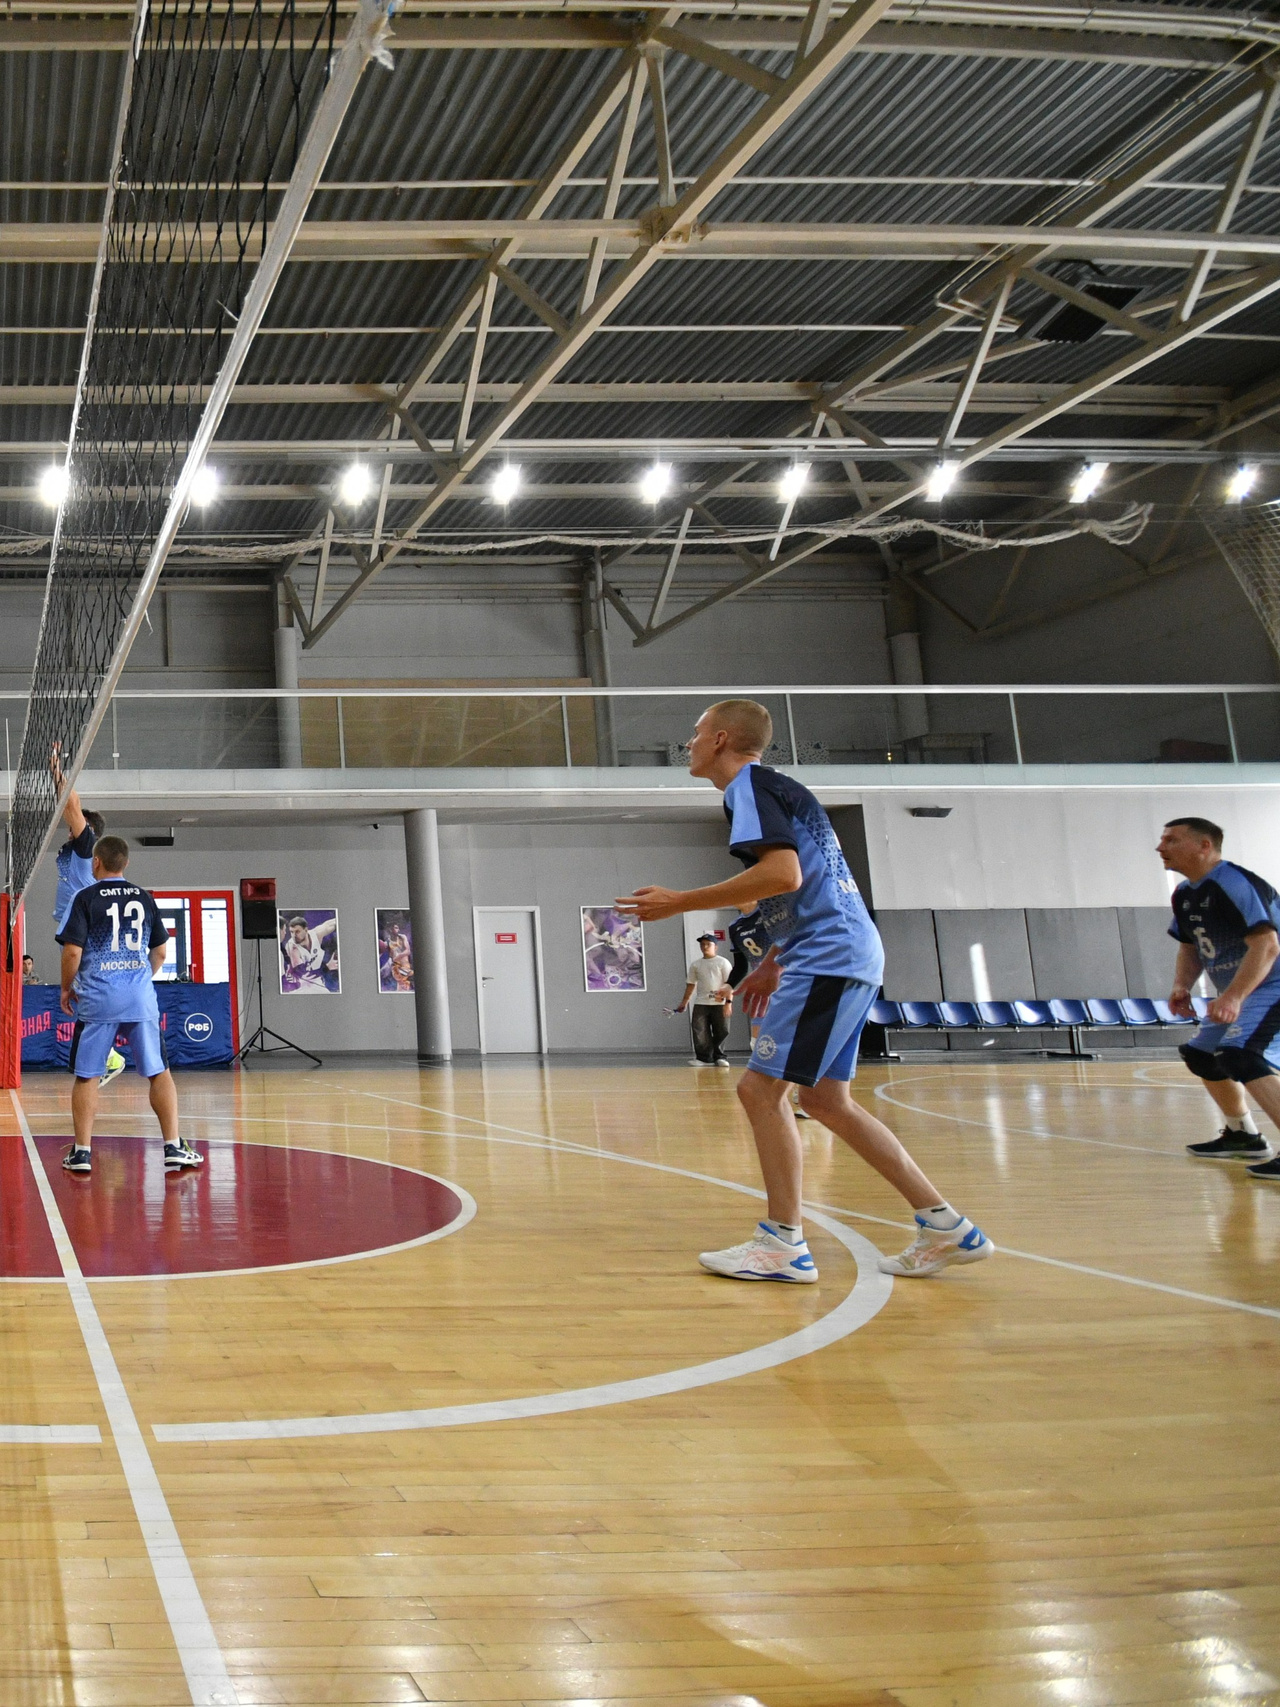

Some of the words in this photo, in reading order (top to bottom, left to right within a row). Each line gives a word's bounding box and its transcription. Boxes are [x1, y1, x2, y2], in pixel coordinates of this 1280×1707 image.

[99, 888, 122, 897] СМТ
[123, 887, 141, 896] №3
[106, 900, 146, 952] 13
[742, 937, 763, 957] 8
[100, 960, 147, 971] МОСКВА
[188, 1022, 210, 1032] РФБ
